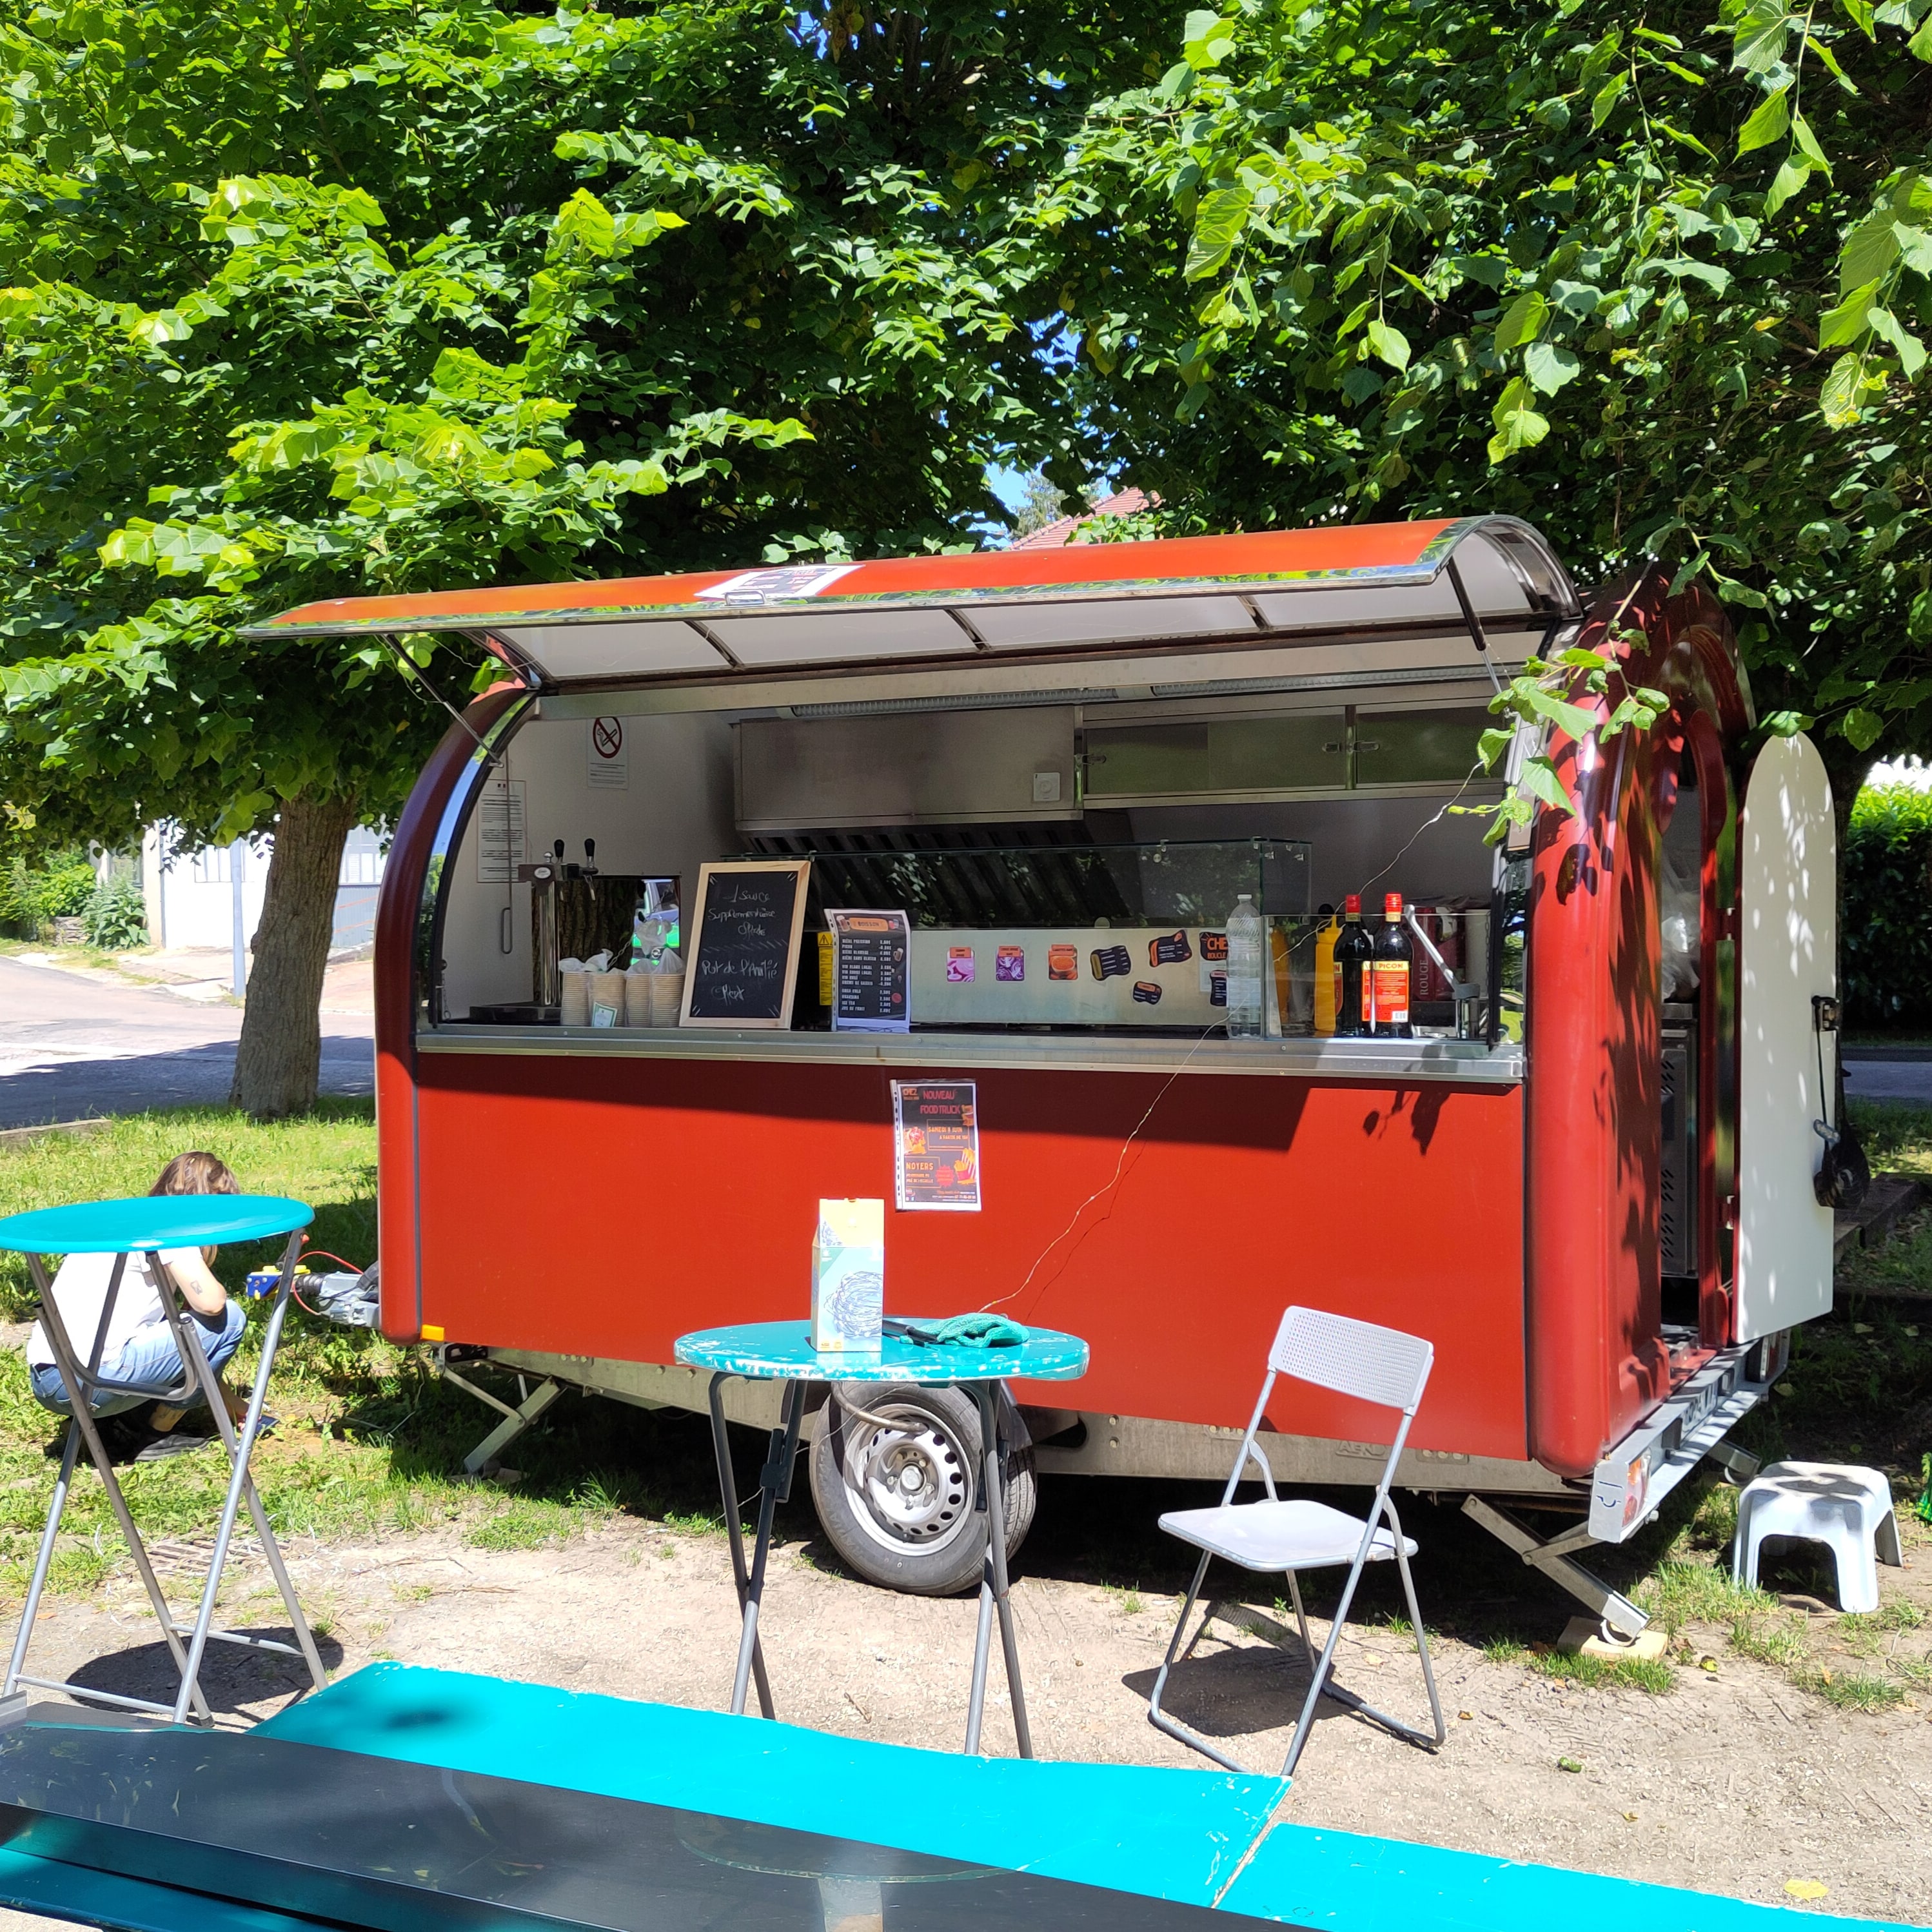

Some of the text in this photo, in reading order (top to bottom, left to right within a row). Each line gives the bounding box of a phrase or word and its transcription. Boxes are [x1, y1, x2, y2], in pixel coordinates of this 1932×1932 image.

[1207, 937, 1228, 951] CHE
[1420, 960, 1428, 995] ROUGE
[923, 1090, 955, 1100] NOUVEAU
[920, 1105, 960, 1114] FOOD TRUCK
[906, 1162, 934, 1170] NOYERS
